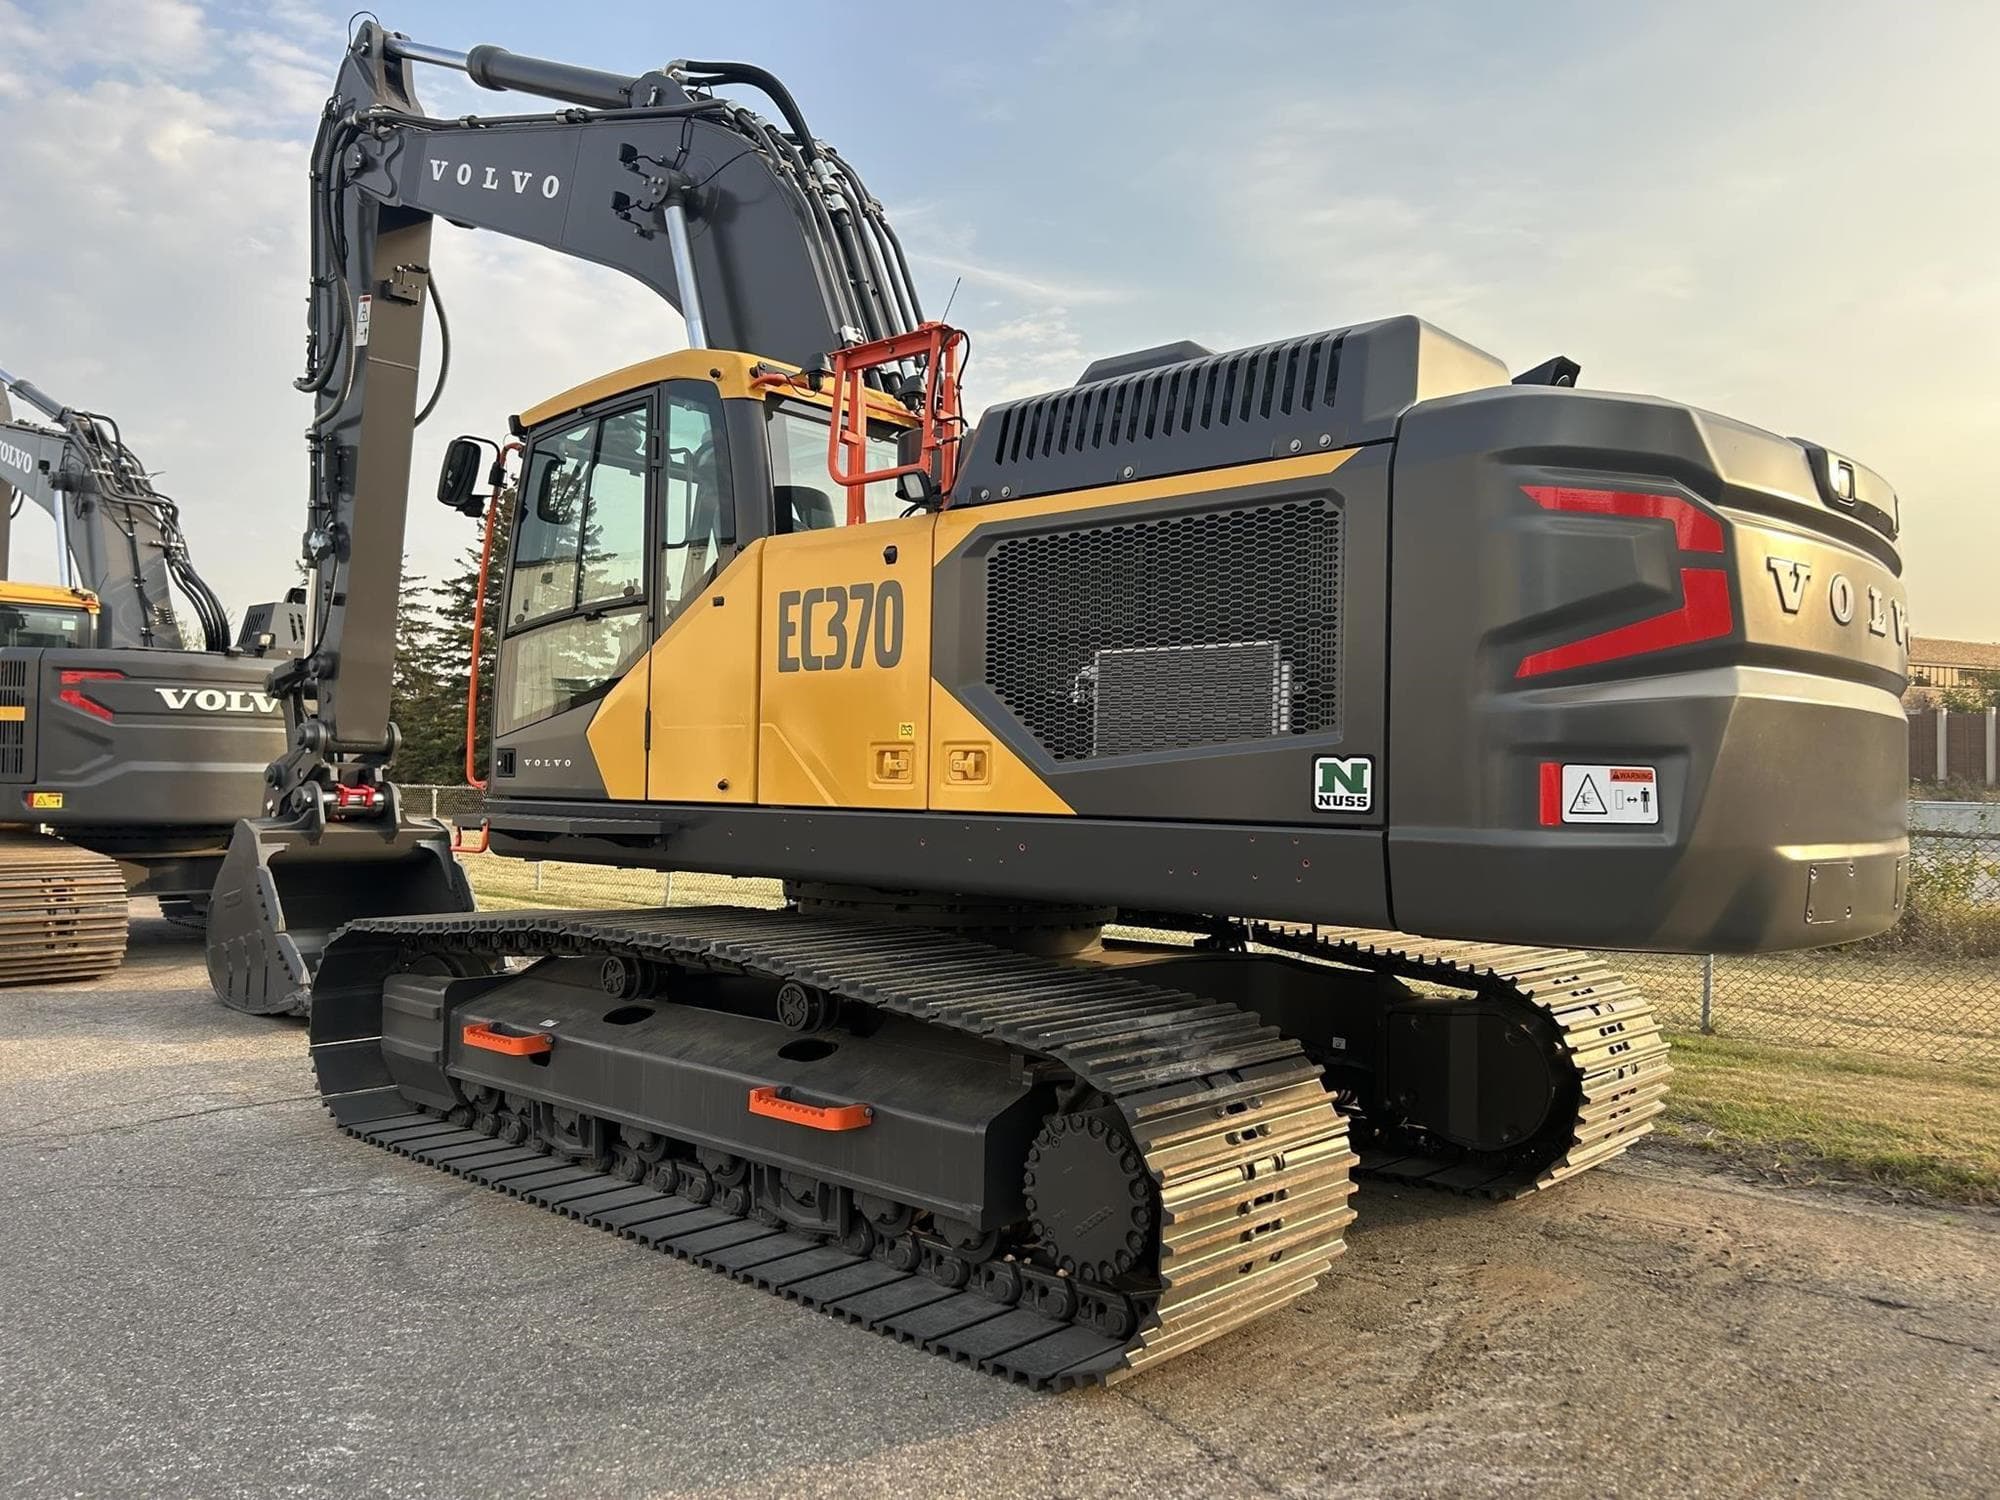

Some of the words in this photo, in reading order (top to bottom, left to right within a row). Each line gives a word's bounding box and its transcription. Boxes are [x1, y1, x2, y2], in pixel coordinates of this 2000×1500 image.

[430, 159, 560, 199] VOLVO
[0, 440, 32, 474] OLVO
[1766, 556, 1910, 655] VOLV
[778, 579, 904, 673] EC370
[154, 688, 280, 713] VOLV
[524, 759, 571, 767] VOLVO
[1319, 762, 1368, 794] N
[1318, 794, 1368, 808] NUSS
